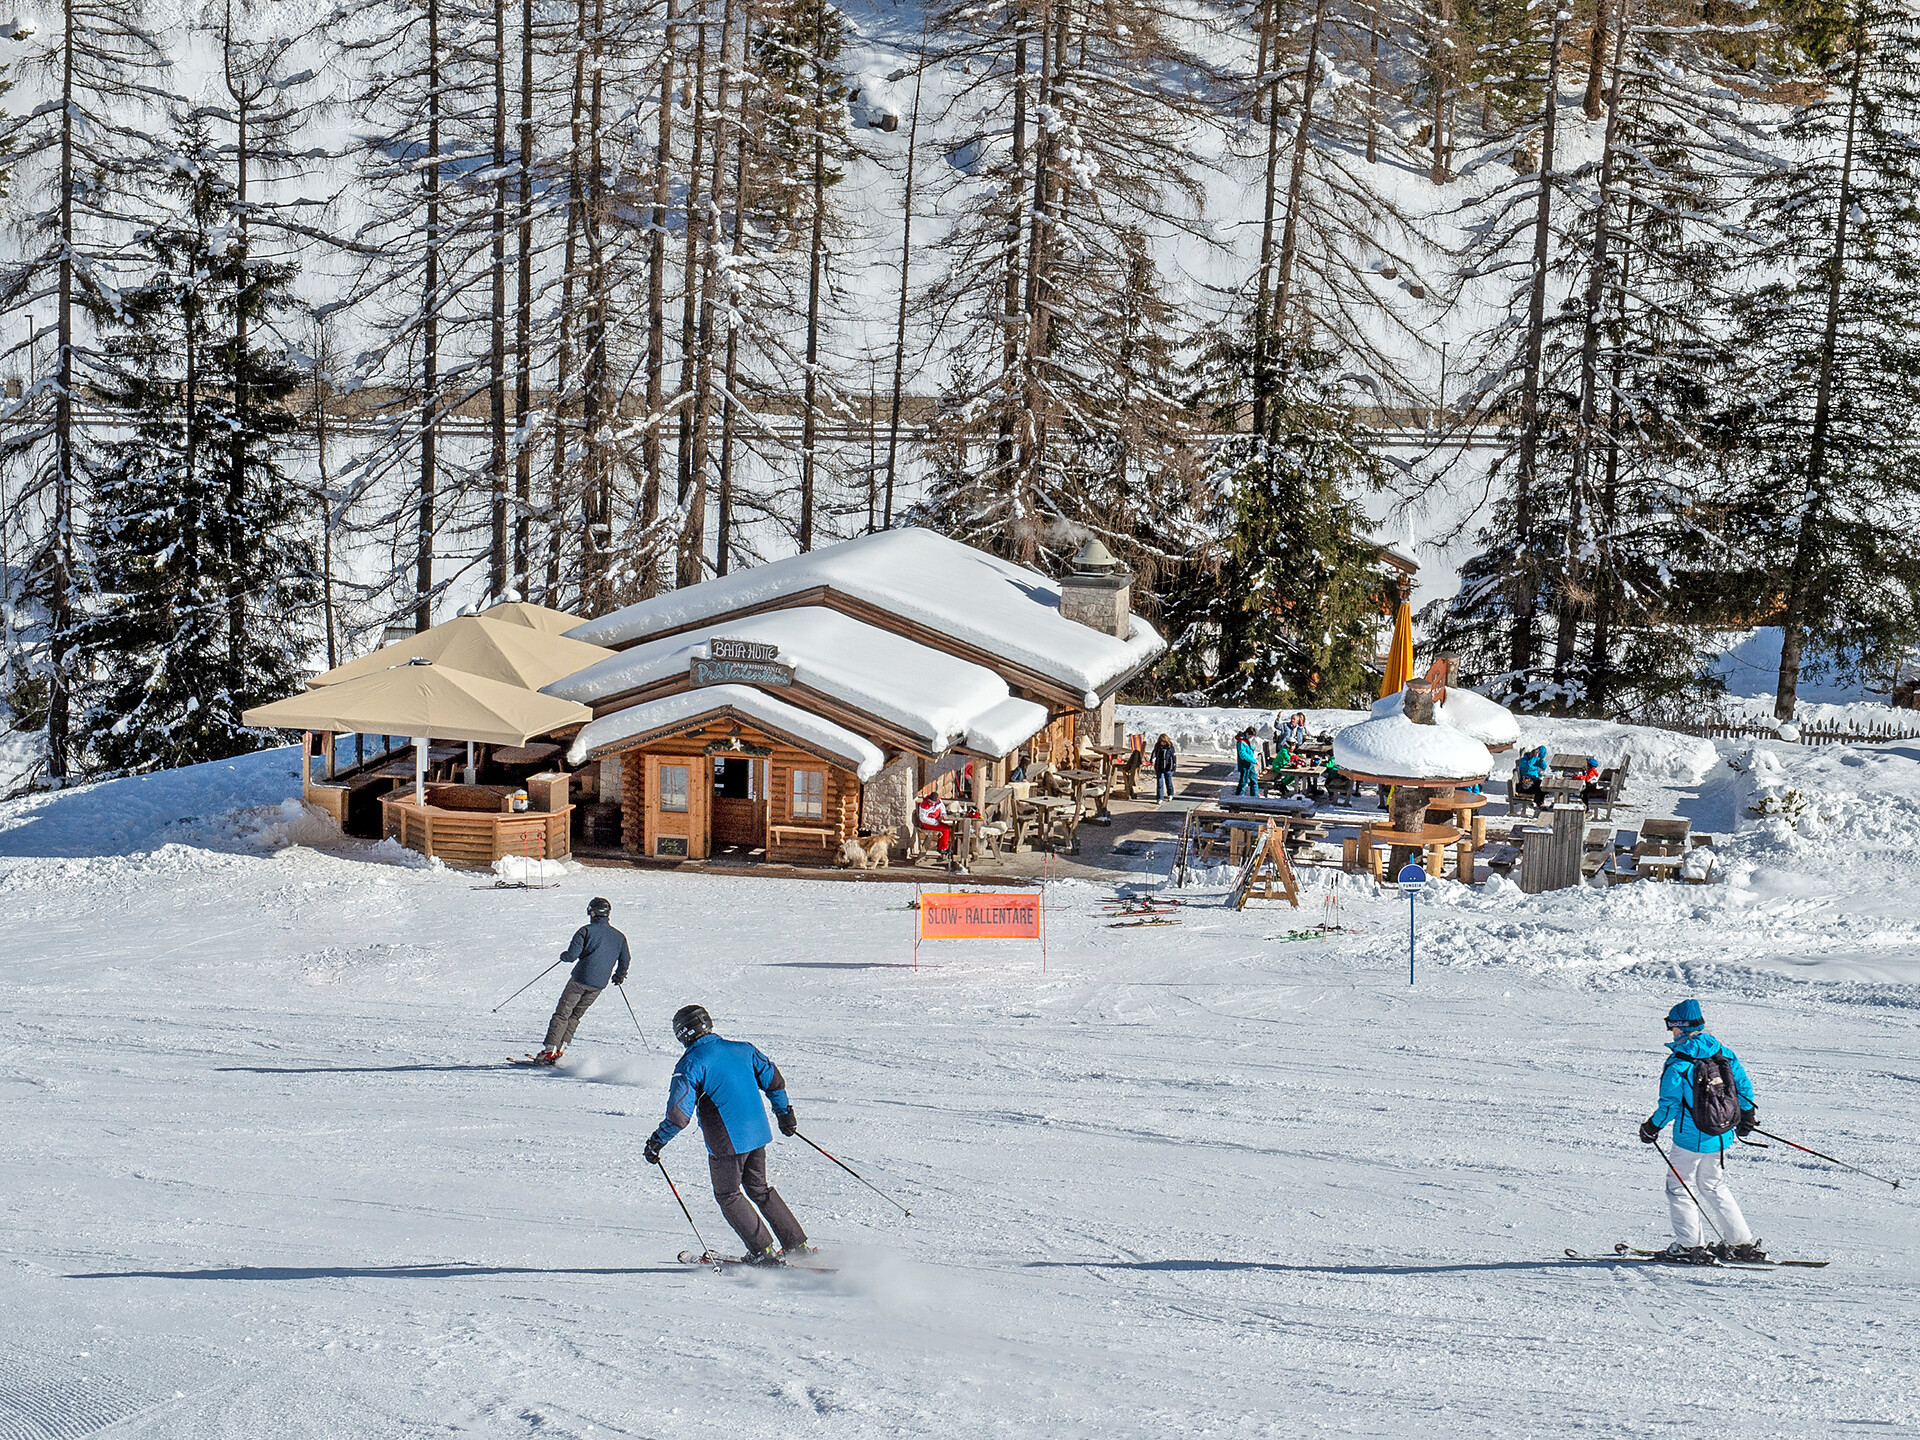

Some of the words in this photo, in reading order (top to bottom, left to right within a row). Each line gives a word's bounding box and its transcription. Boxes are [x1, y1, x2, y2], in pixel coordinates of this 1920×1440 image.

[724, 661, 788, 684] Valentini
[748, 664, 782, 673] RISTORANTE
[965, 908, 1033, 924] RALLENTARE
